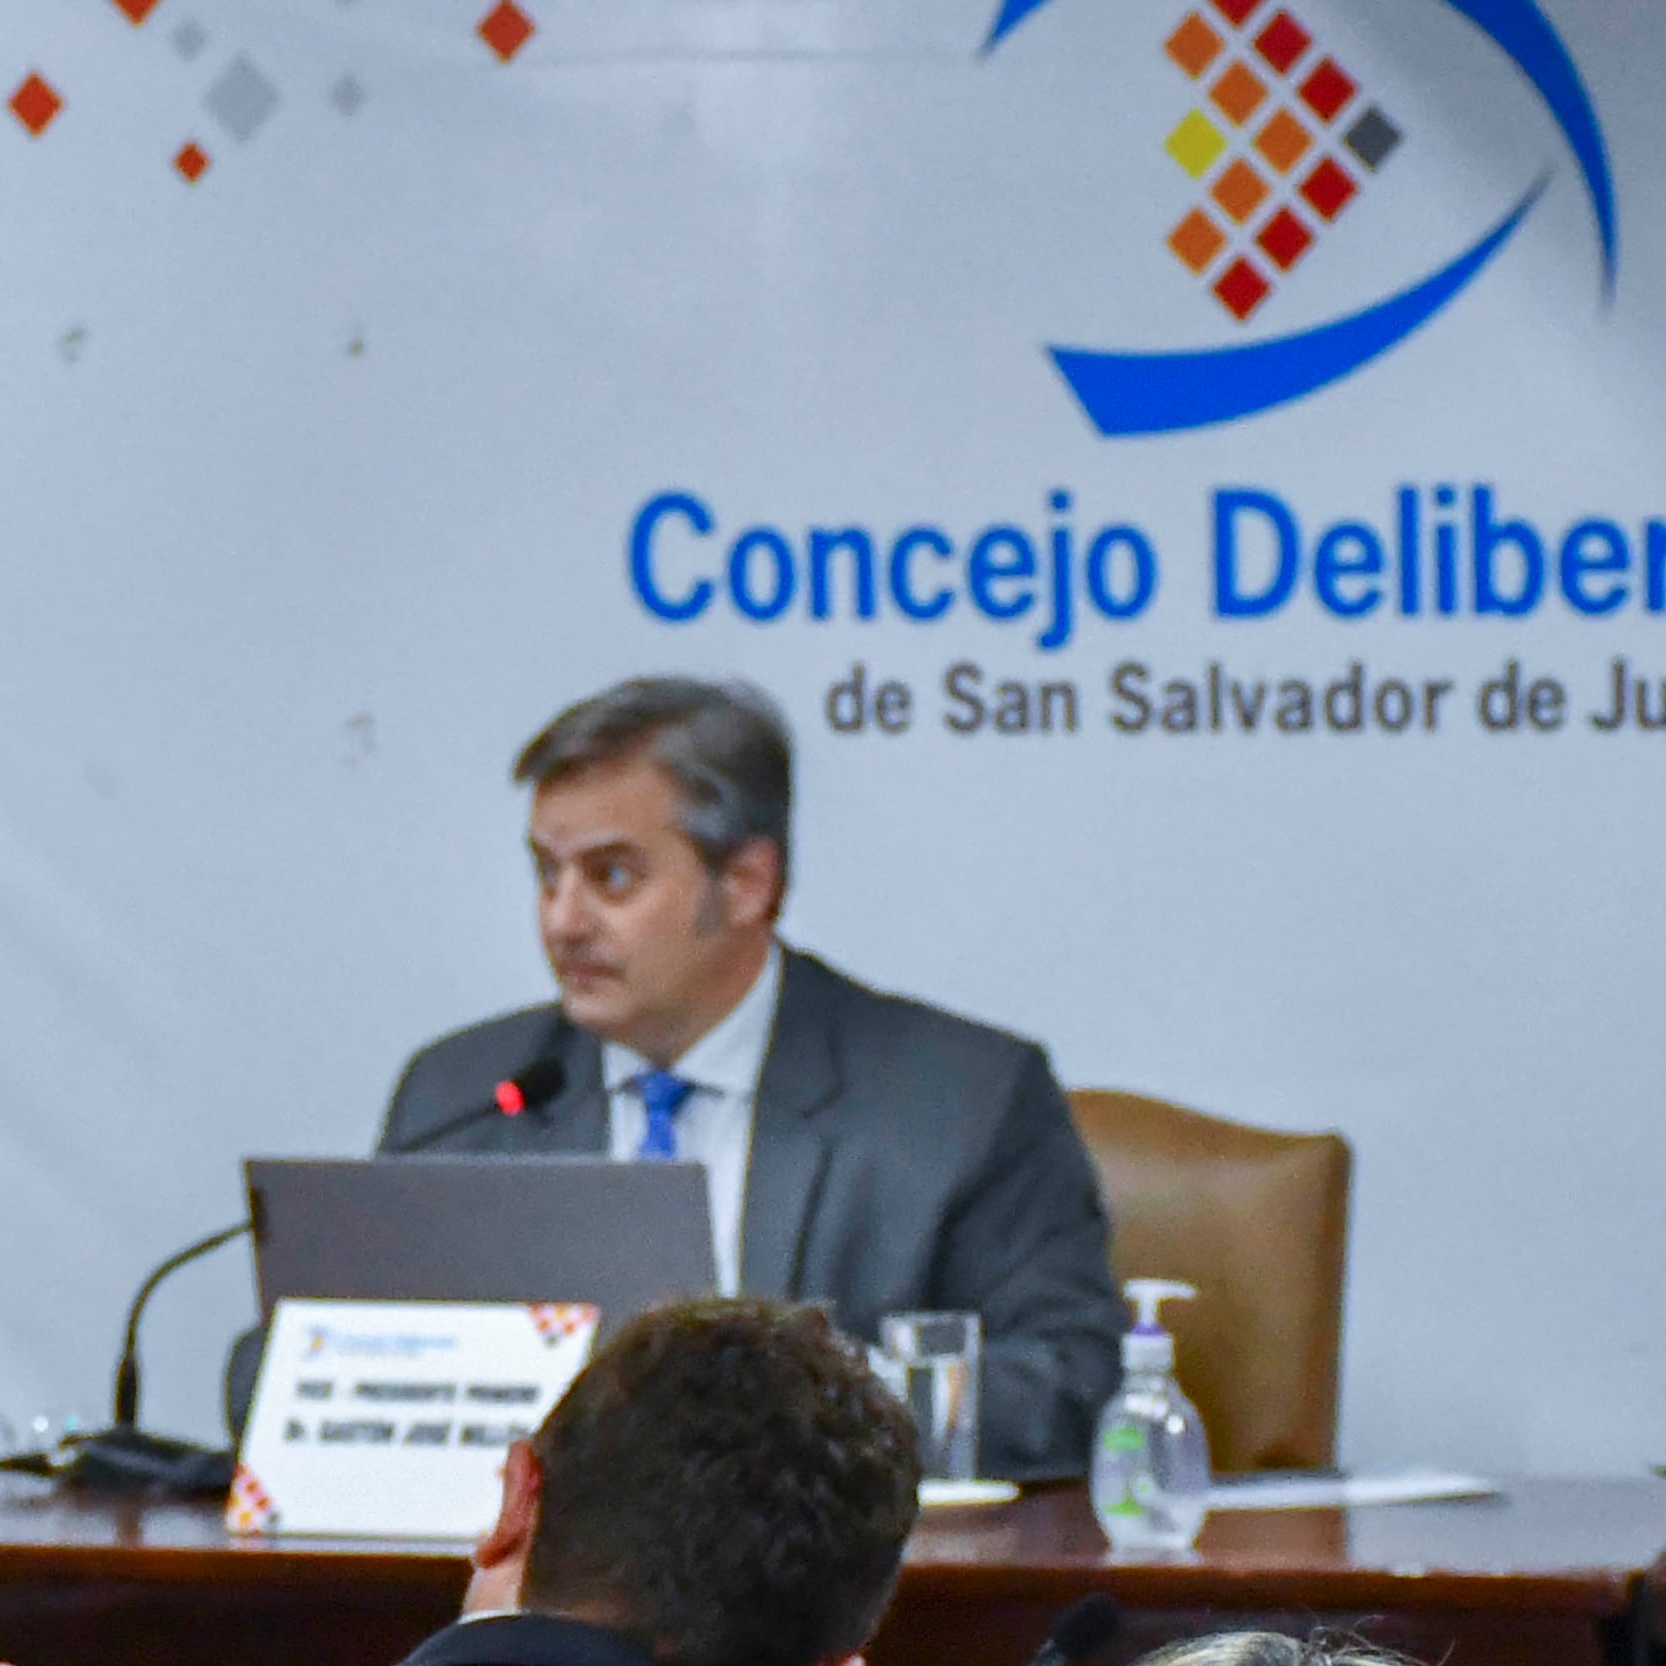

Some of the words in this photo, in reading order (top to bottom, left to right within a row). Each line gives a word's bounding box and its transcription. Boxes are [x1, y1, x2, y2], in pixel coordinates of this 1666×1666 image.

[627, 490, 1161, 651] Concejo
[824, 665, 913, 736] de
[944, 663, 1080, 736] San
[1110, 662, 1454, 736] Salvador
[1476, 660, 1568, 734] de
